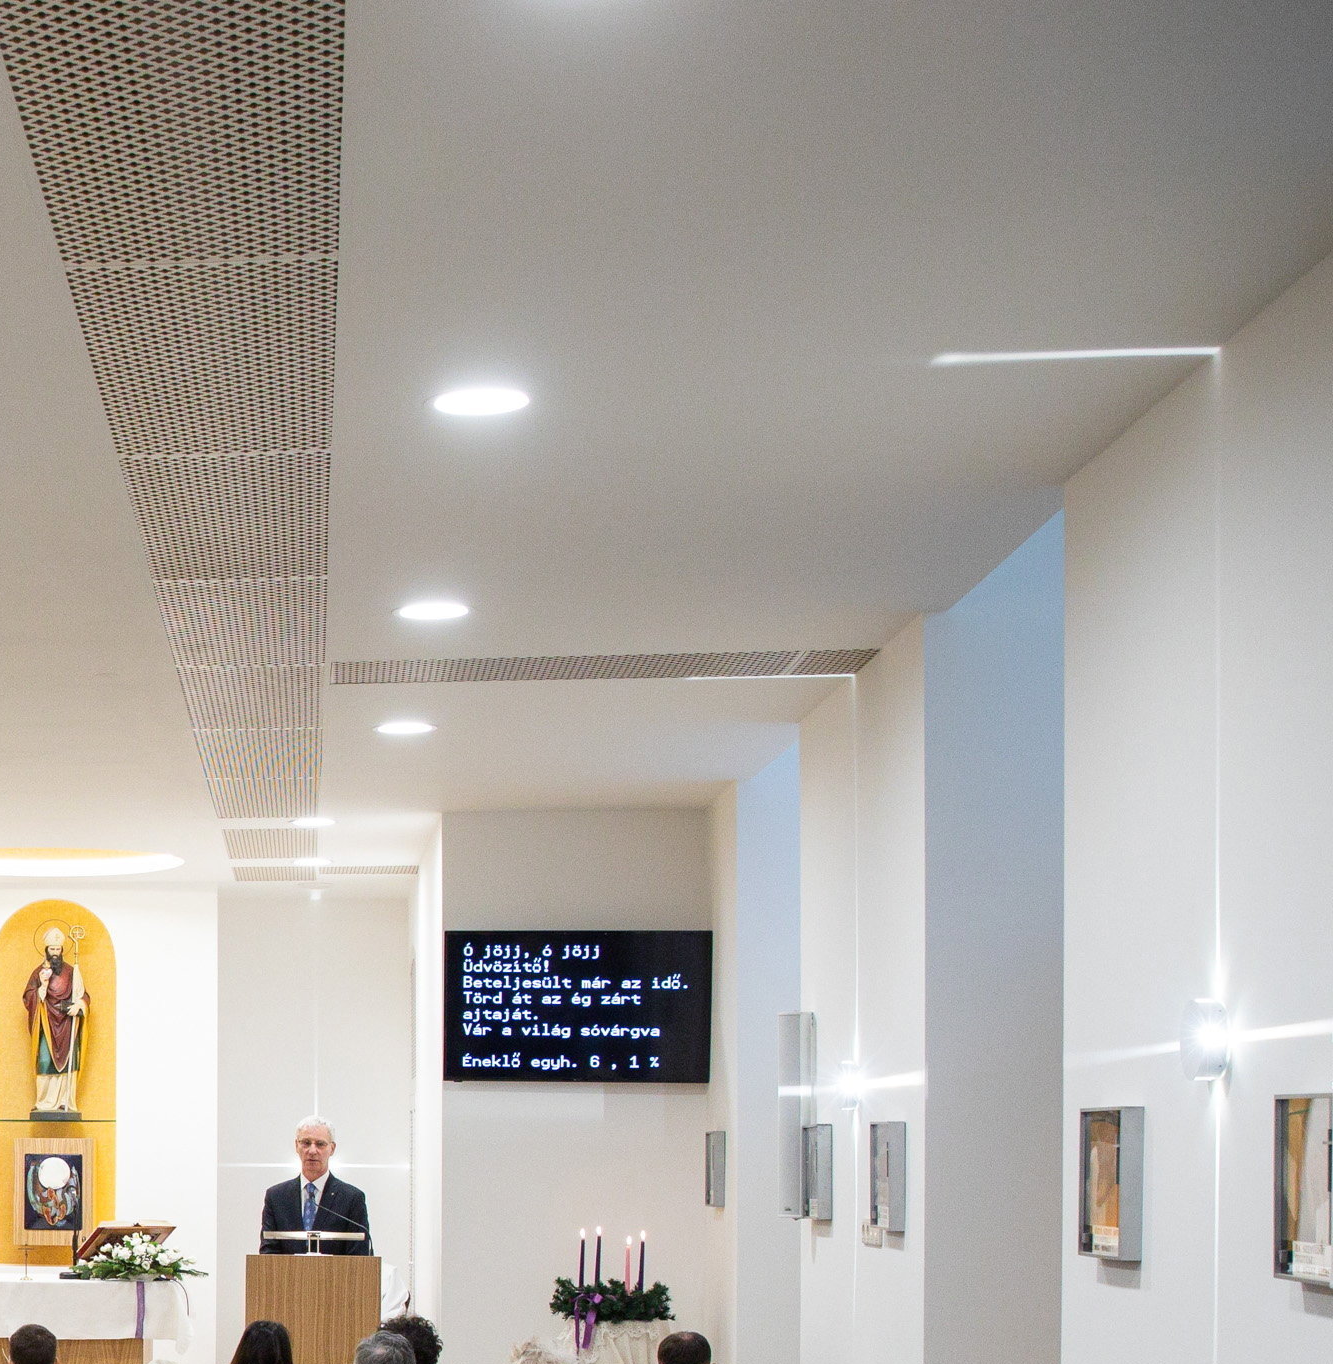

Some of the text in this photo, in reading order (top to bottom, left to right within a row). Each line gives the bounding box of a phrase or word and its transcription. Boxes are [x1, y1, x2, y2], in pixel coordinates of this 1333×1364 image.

[463, 942, 600, 960] Ó jöjj, ó jöjj
[463, 957, 549, 973] Üdvözítő!
[463, 973, 688, 991] Beteljesült már az idő.
[463, 991, 641, 1007] Törd át az ég zárt
[462, 1008, 538, 1023] ajtaját.
[462, 1022, 660, 1039] Vár a világ sóvárgva
[462, 1052, 521, 1068] Éneklő
[530, 1055, 577, 1070] egyh.
